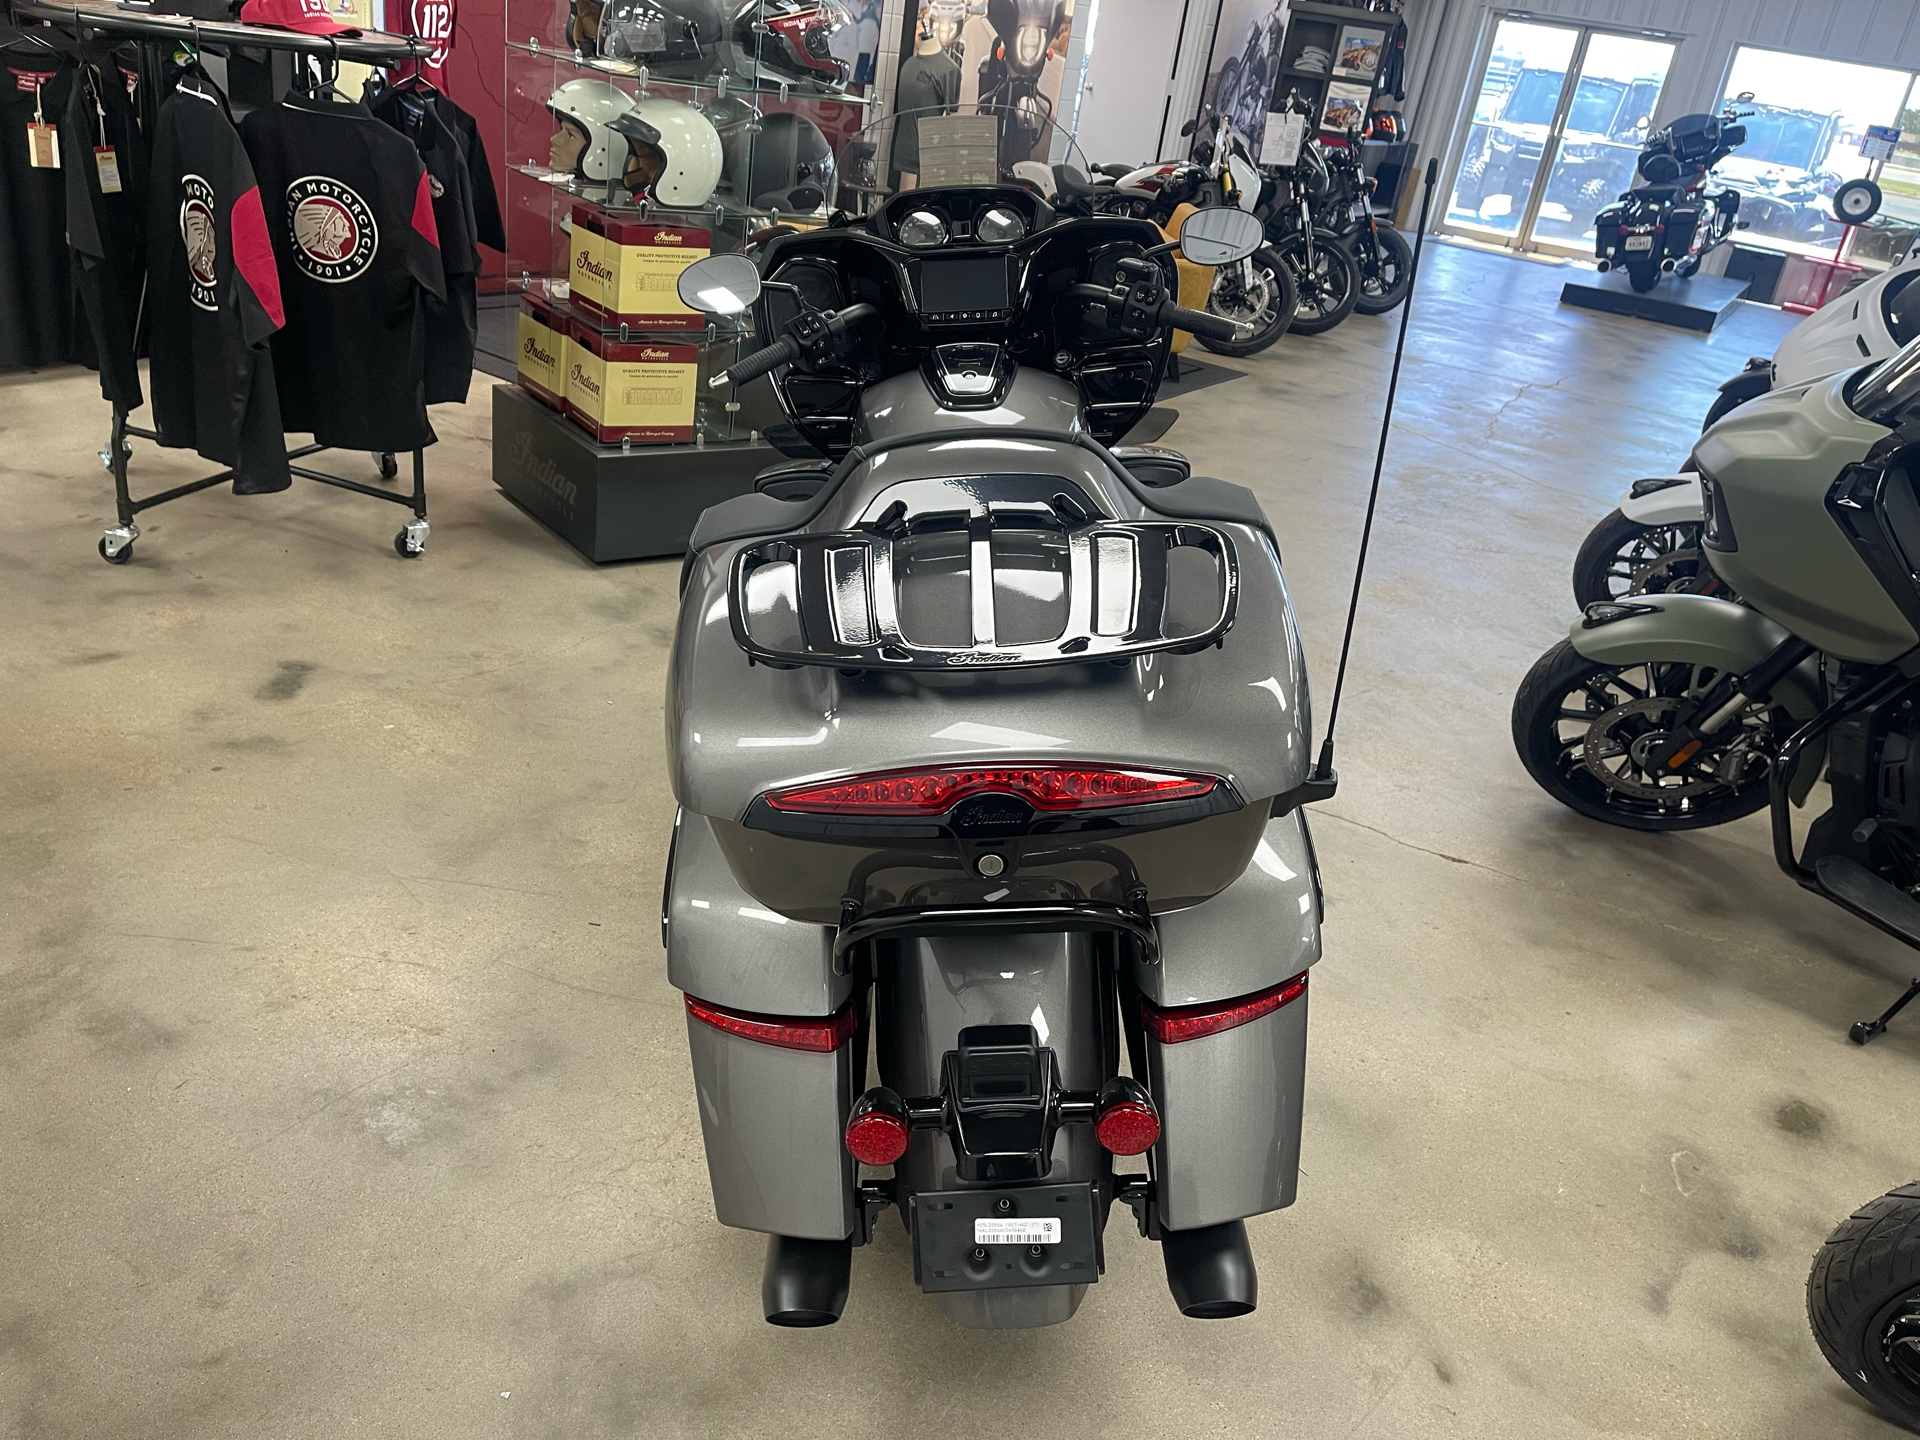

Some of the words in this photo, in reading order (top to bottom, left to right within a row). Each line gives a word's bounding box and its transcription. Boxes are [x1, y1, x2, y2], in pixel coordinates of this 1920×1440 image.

[422, 4, 449, 38] 112
[306, 182, 372, 266] MOTORCYCLE
[653, 231, 683, 241] Indian
[308, 261, 341, 276] 1901
[576, 250, 613, 282] Indian
[191, 282, 216, 303] 1901
[523, 337, 556, 369] Indian
[640, 348, 670, 357] Indian
[571, 363, 600, 396] Indian
[508, 429, 578, 508] Indian
[946, 651, 1024, 665] Indian
[960, 805, 1024, 827] Indian
